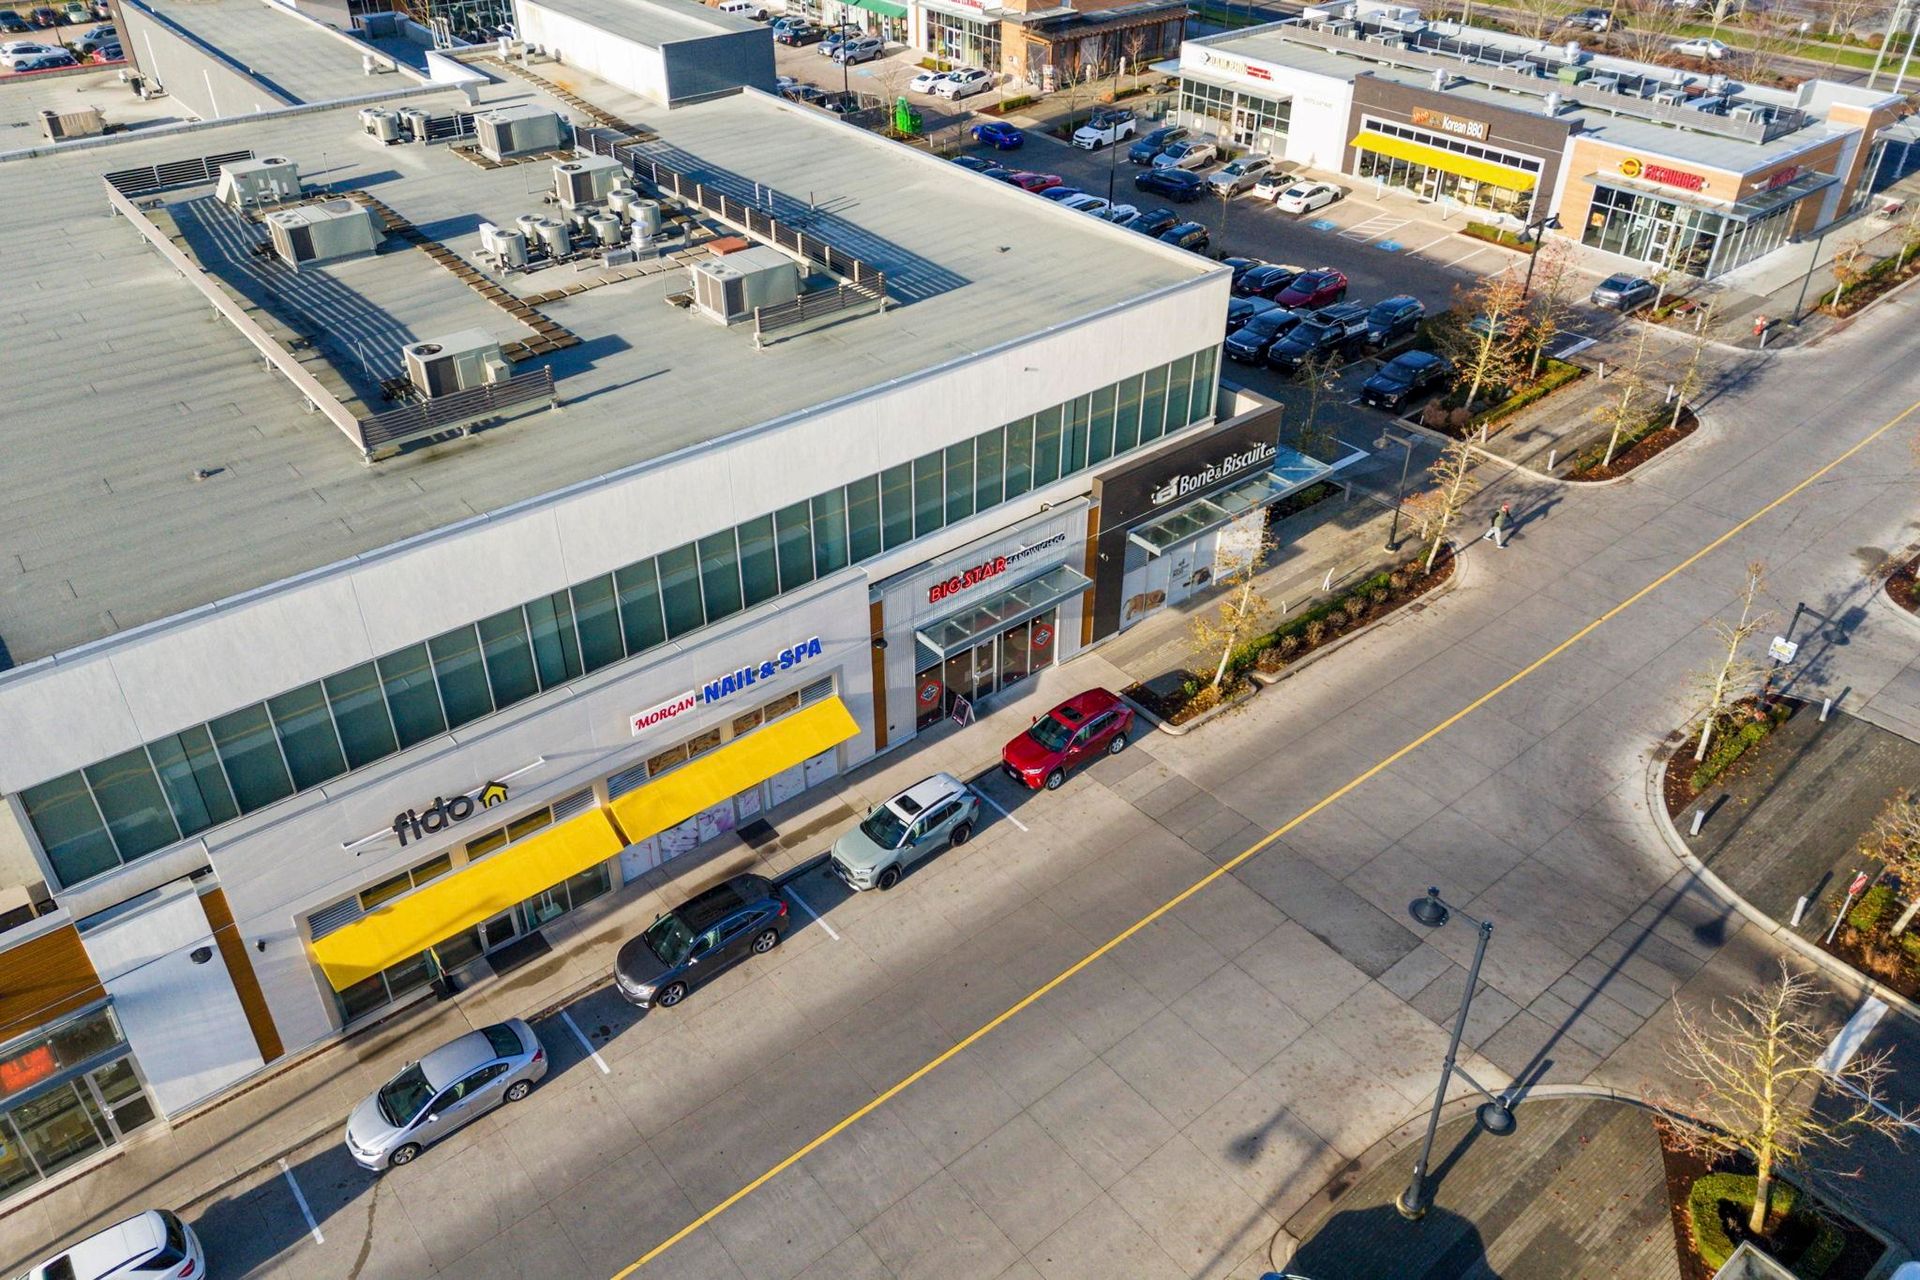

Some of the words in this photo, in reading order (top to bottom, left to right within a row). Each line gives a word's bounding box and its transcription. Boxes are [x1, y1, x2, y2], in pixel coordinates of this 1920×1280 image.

[1442, 115, 1466, 134] Korean
[1467, 121, 1483, 139] BBQ
[1179, 468, 1216, 496] Bone
[1222, 443, 1267, 477] Biscuit
[929, 576, 962, 604] BIG
[960, 555, 1007, 589] STAR
[635, 696, 695, 730] MORGAN
[702, 666, 757, 704] NAIL
[758, 660, 776, 681] &
[777, 635, 823, 671] SPA
[392, 795, 475, 847] fido
